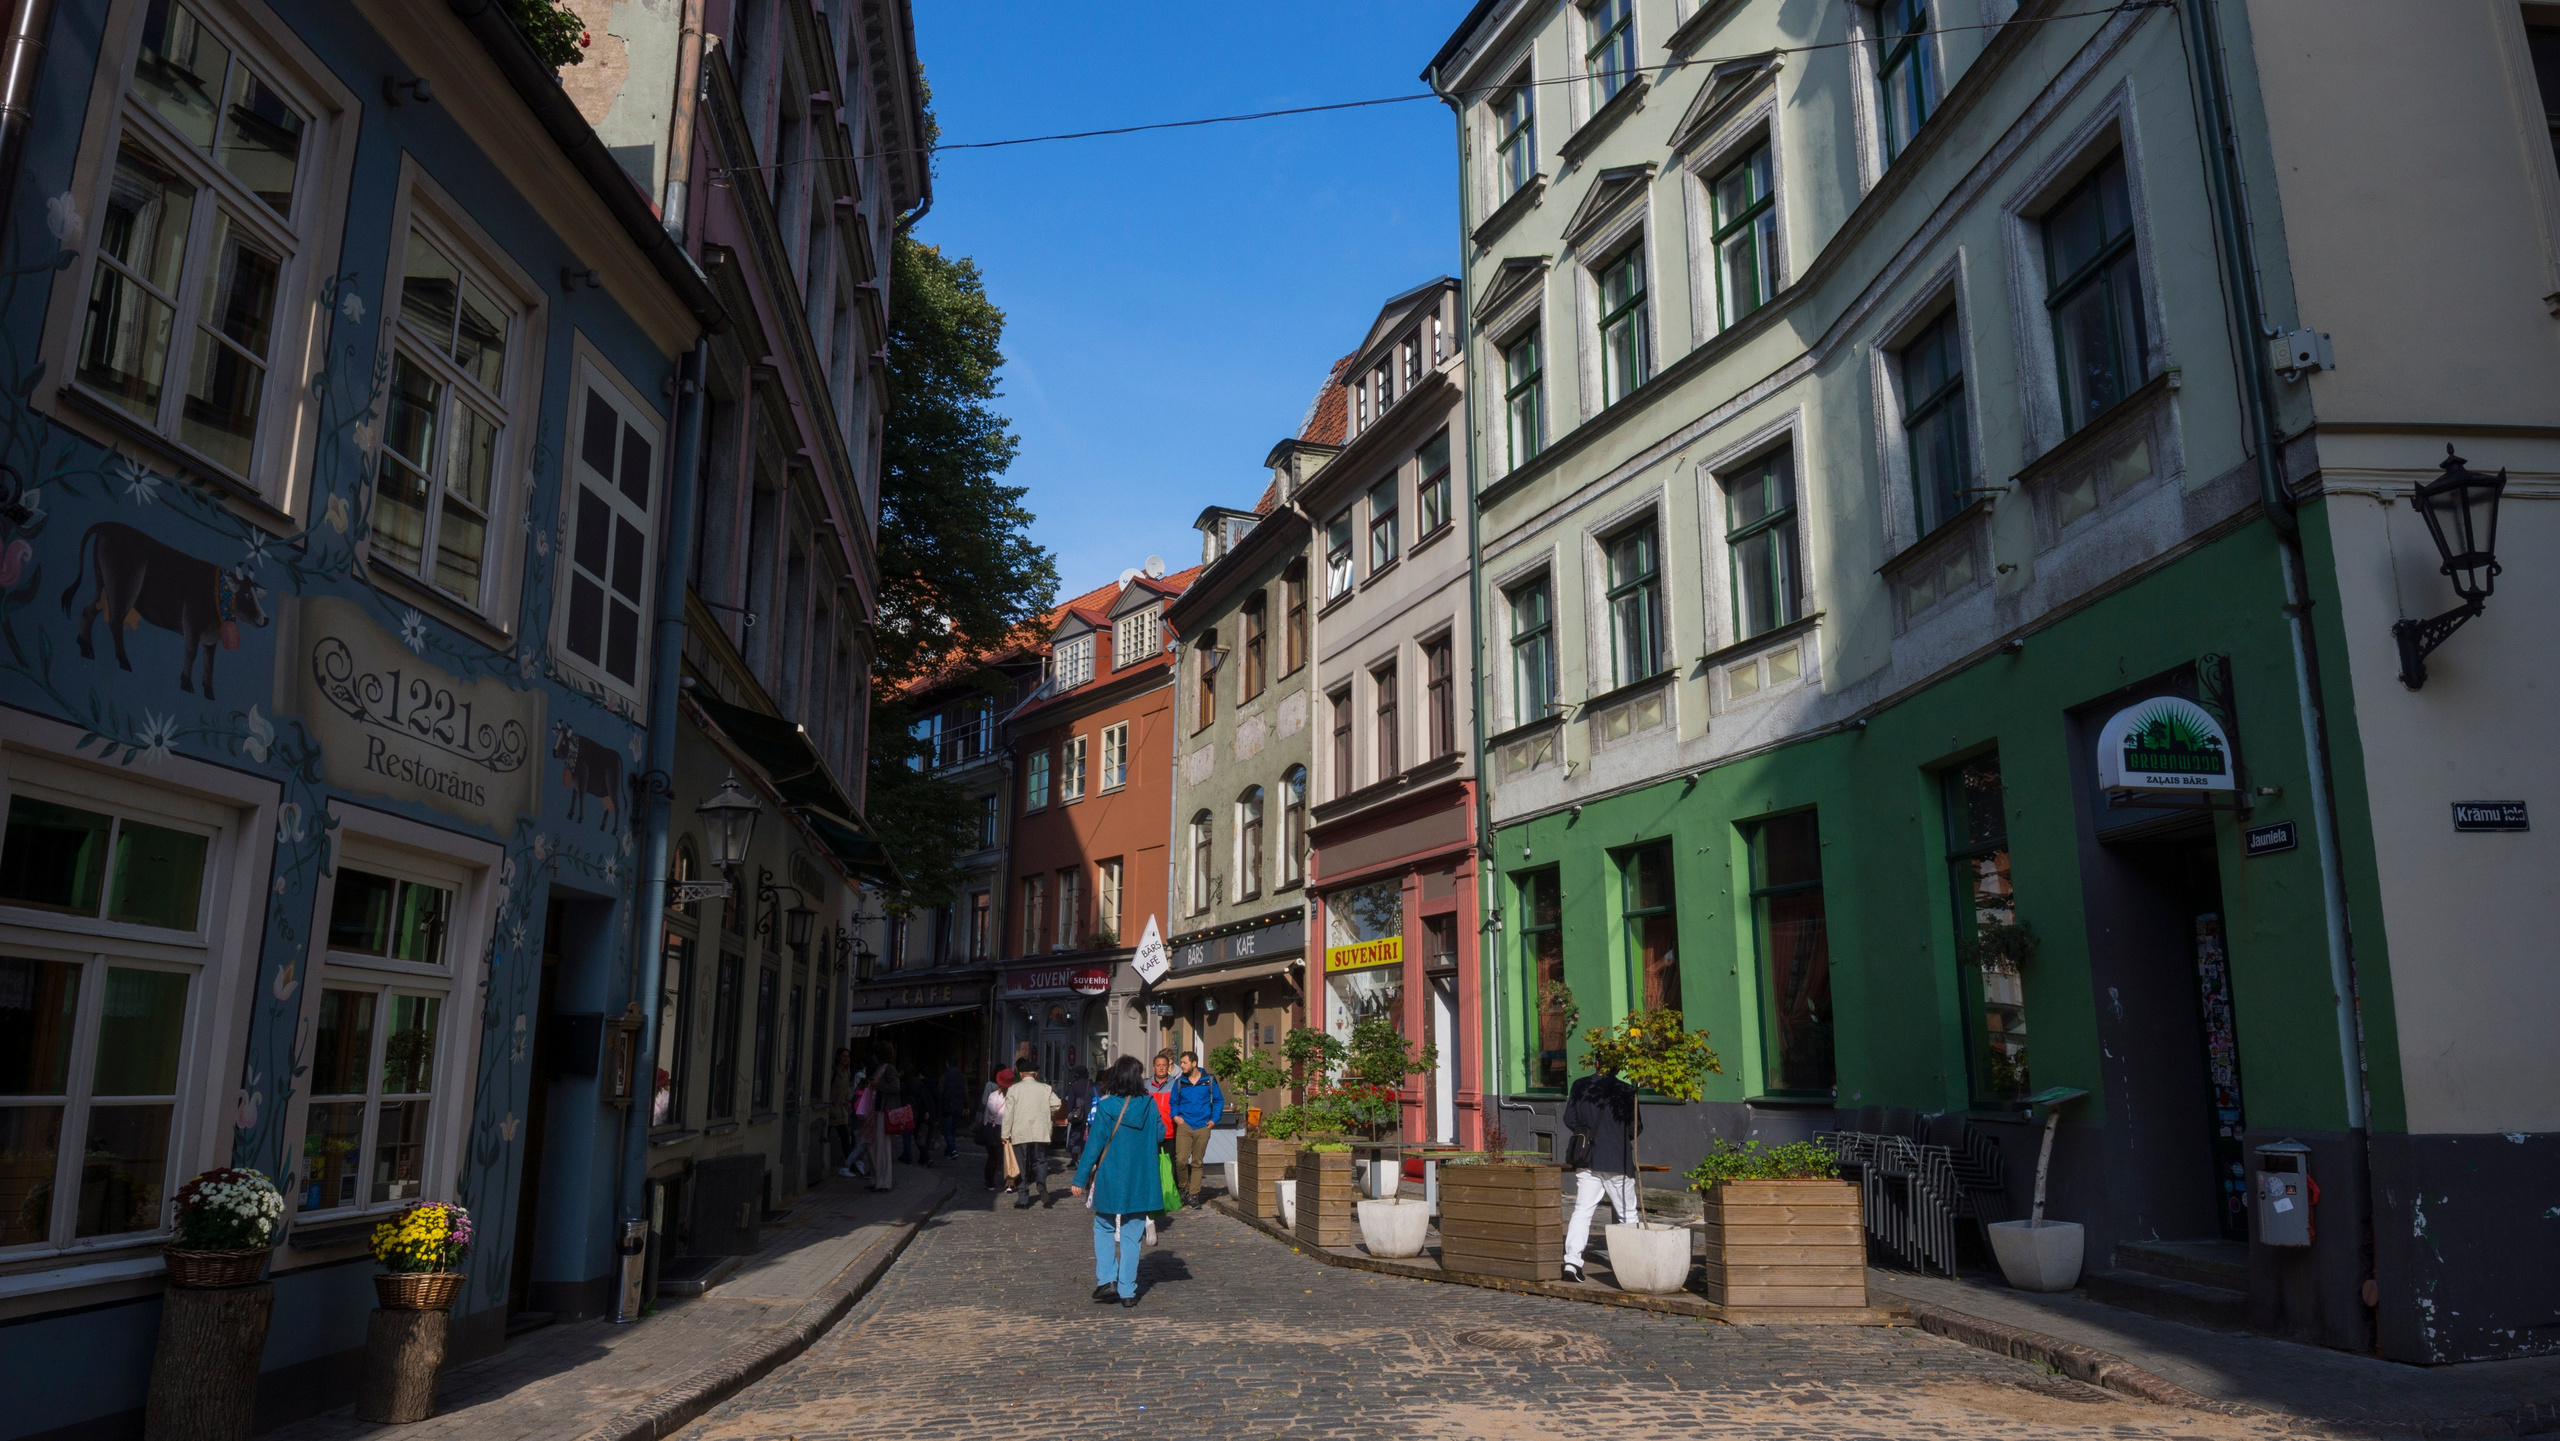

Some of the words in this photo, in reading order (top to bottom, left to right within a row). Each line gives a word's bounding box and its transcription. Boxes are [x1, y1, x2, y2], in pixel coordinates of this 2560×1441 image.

[383, 669, 475, 753] 1221
[364, 734, 485, 807] Restorāns
[2146, 776, 2180, 785] ZAĻAIS
[2182, 776, 2208, 785] BĀRS
[2456, 806, 2501, 821] Krāmu
[2250, 829, 2287, 848] Jauniela
[1141, 940, 1162, 959] BĀRS
[1187, 944, 1204, 966] BĀRS
[1334, 940, 1398, 968] SUVENĪRI
[1073, 977, 1109, 985] SUVENĪRI
[901, 985, 952, 1004] CAFE
